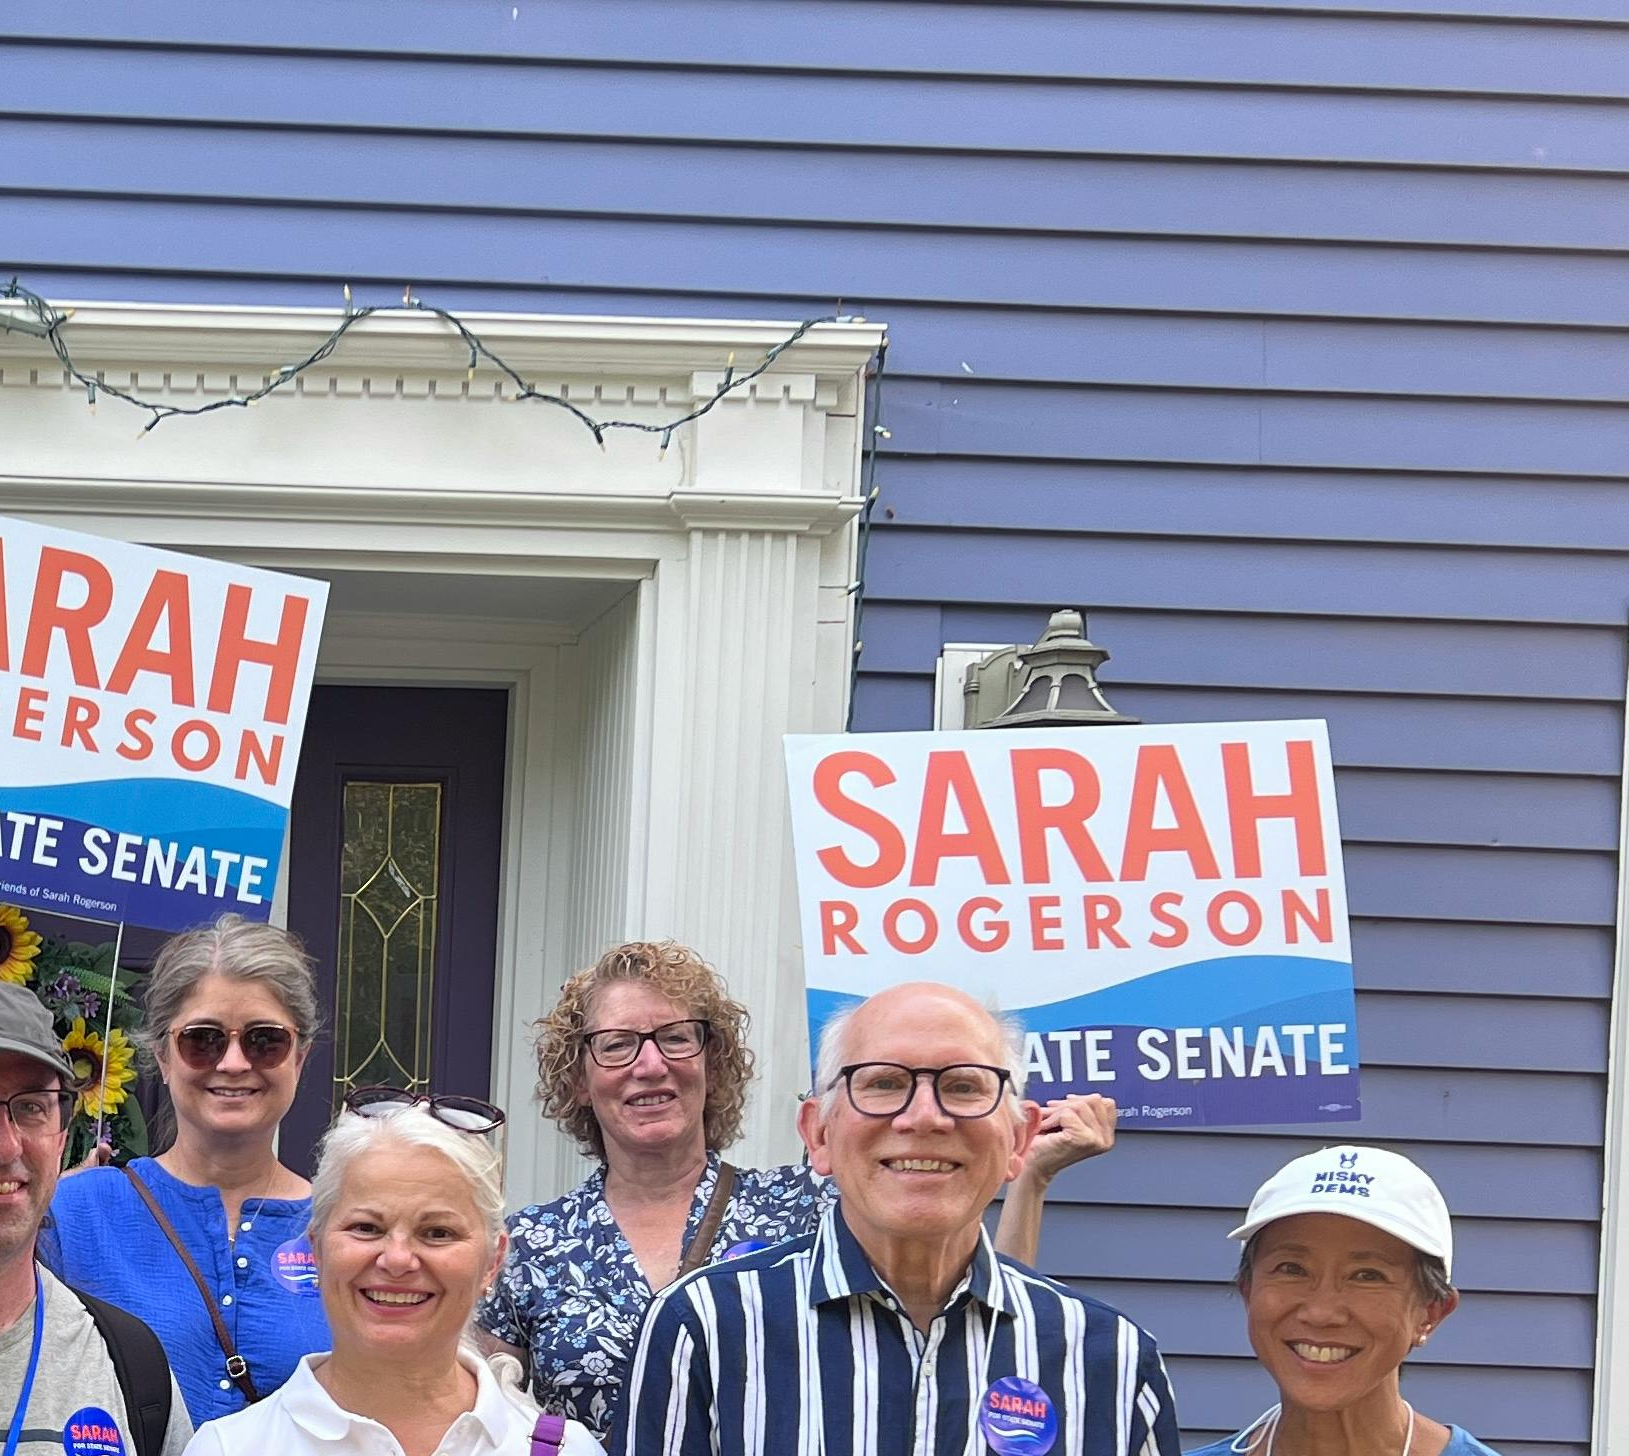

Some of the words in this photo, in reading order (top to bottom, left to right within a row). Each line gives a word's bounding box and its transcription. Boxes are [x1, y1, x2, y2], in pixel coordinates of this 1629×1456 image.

[813, 740, 1328, 888] SARAH
[79, 827, 269, 905] SENATE
[29, 887, 40, 897] of
[42, 888, 70, 903] Sarah
[73, 894, 117, 912] Rogerson
[820, 889, 1333, 954] ROGERSON
[1022, 1030, 1116, 1083] ATE
[1137, 1023, 1350, 1080] SENATE
[1116, 1105, 1139, 1118] arah
[1142, 1105, 1192, 1118] Rogerson
[1311, 1183, 1370, 1198] DEMS
[1315, 1171, 1375, 1185] NISKY
[277, 1252, 316, 1264] SARA
[989, 1391, 1047, 1418] SARAH
[70, 1424, 118, 1444] SARAH
